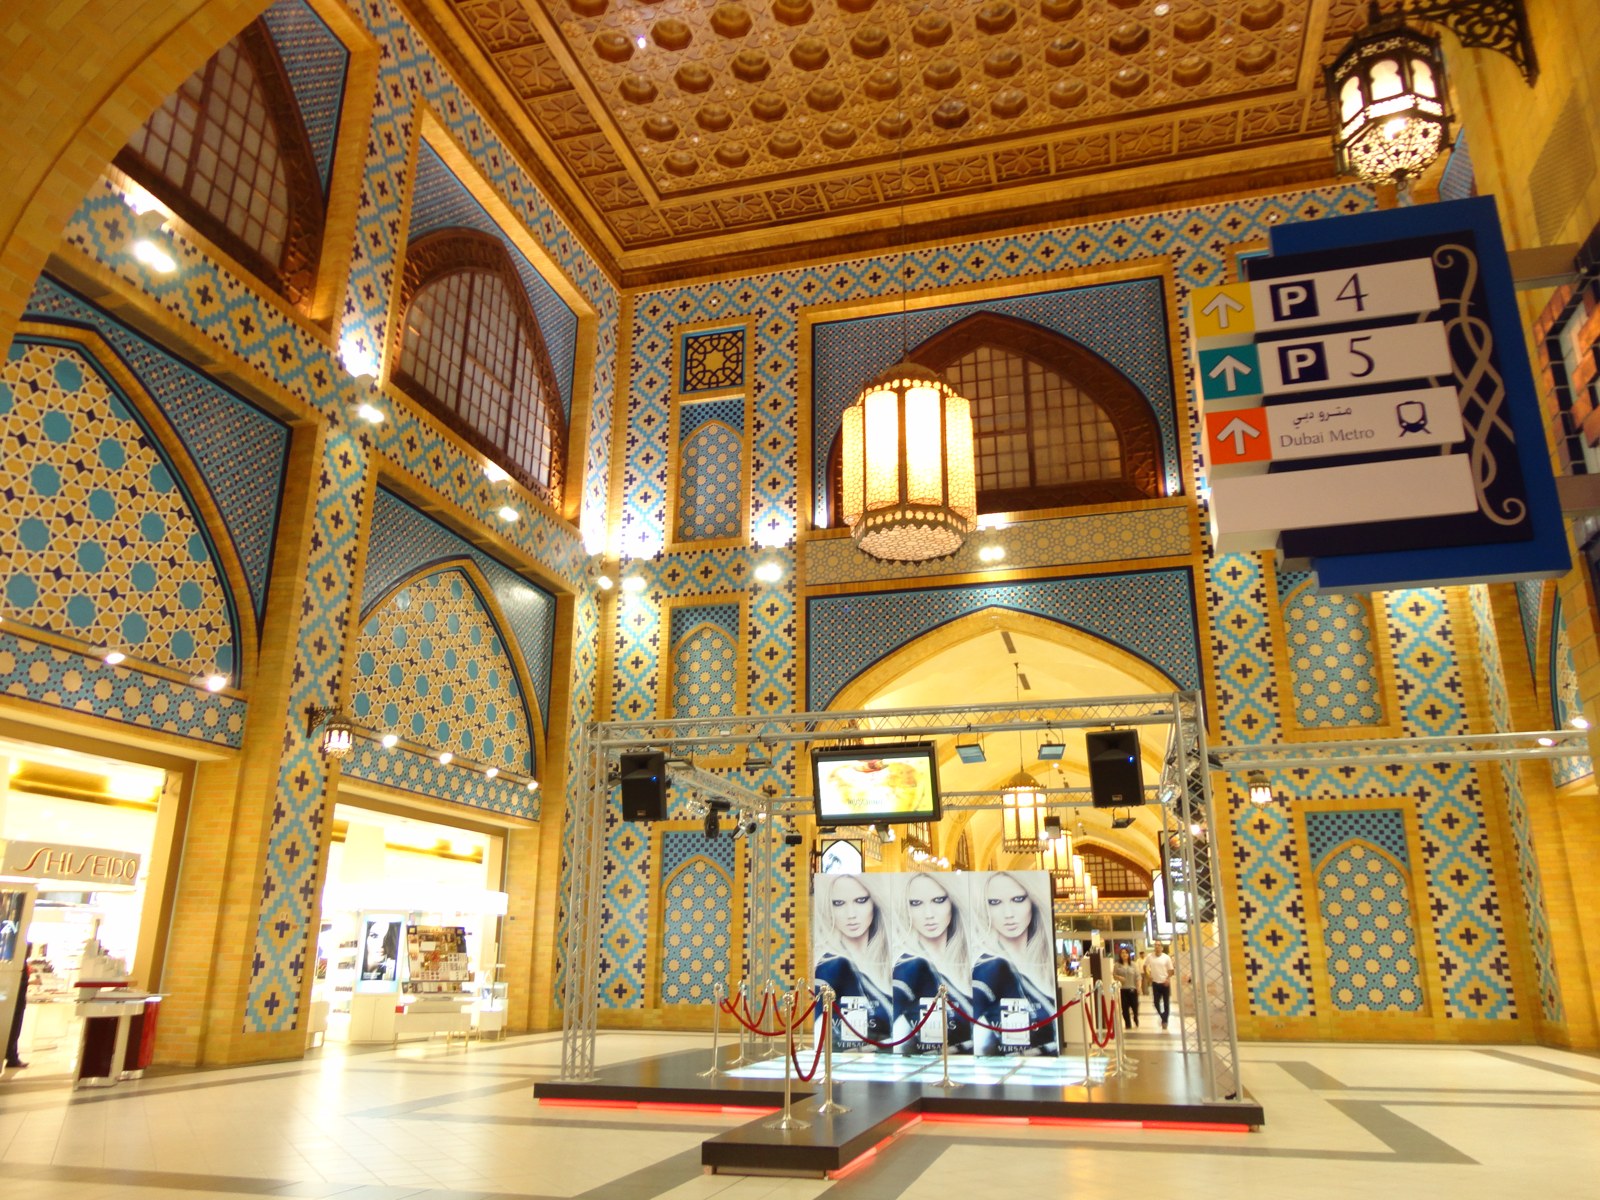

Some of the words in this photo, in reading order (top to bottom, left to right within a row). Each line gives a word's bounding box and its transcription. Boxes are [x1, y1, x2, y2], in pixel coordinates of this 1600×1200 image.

[1279, 285, 1308, 317] P
[1335, 272, 1369, 312] 4
[1287, 347, 1317, 380] P
[1349, 335, 1375, 377] 5
[1293, 411, 1315, 429] دبي
[1280, 432, 1324, 448] Dubai
[1331, 428, 1375, 443] Metro
[11, 846, 138, 881] SHISEIDO
